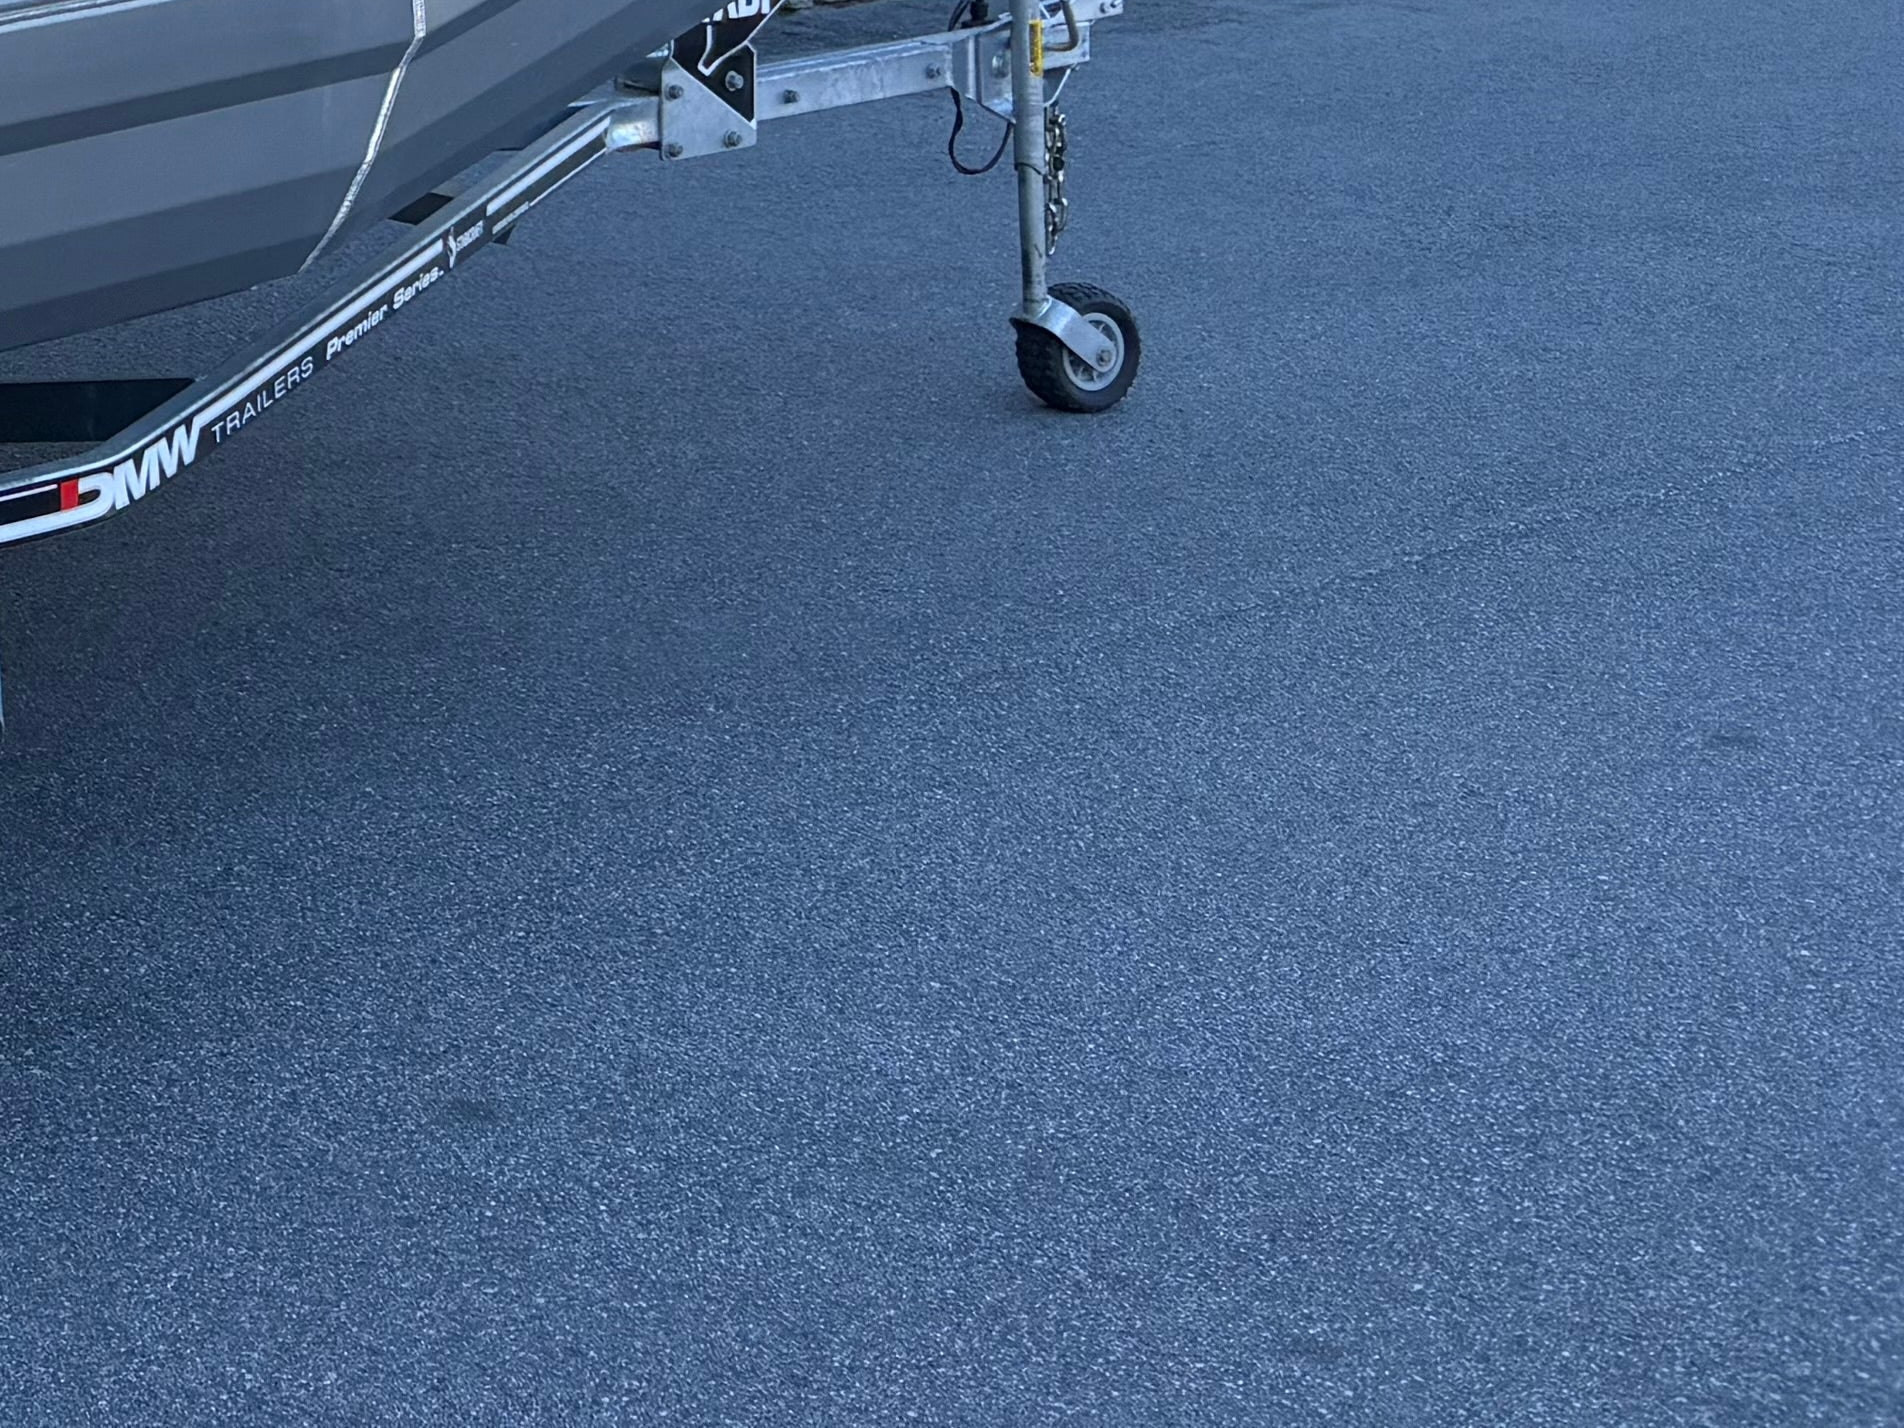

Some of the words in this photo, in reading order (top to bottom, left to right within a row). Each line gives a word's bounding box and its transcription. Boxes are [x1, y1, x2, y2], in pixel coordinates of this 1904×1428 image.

[60, 418, 202, 521] DMW
[210, 356, 315, 443] TRAILERS
[325, 303, 388, 361] Premier
